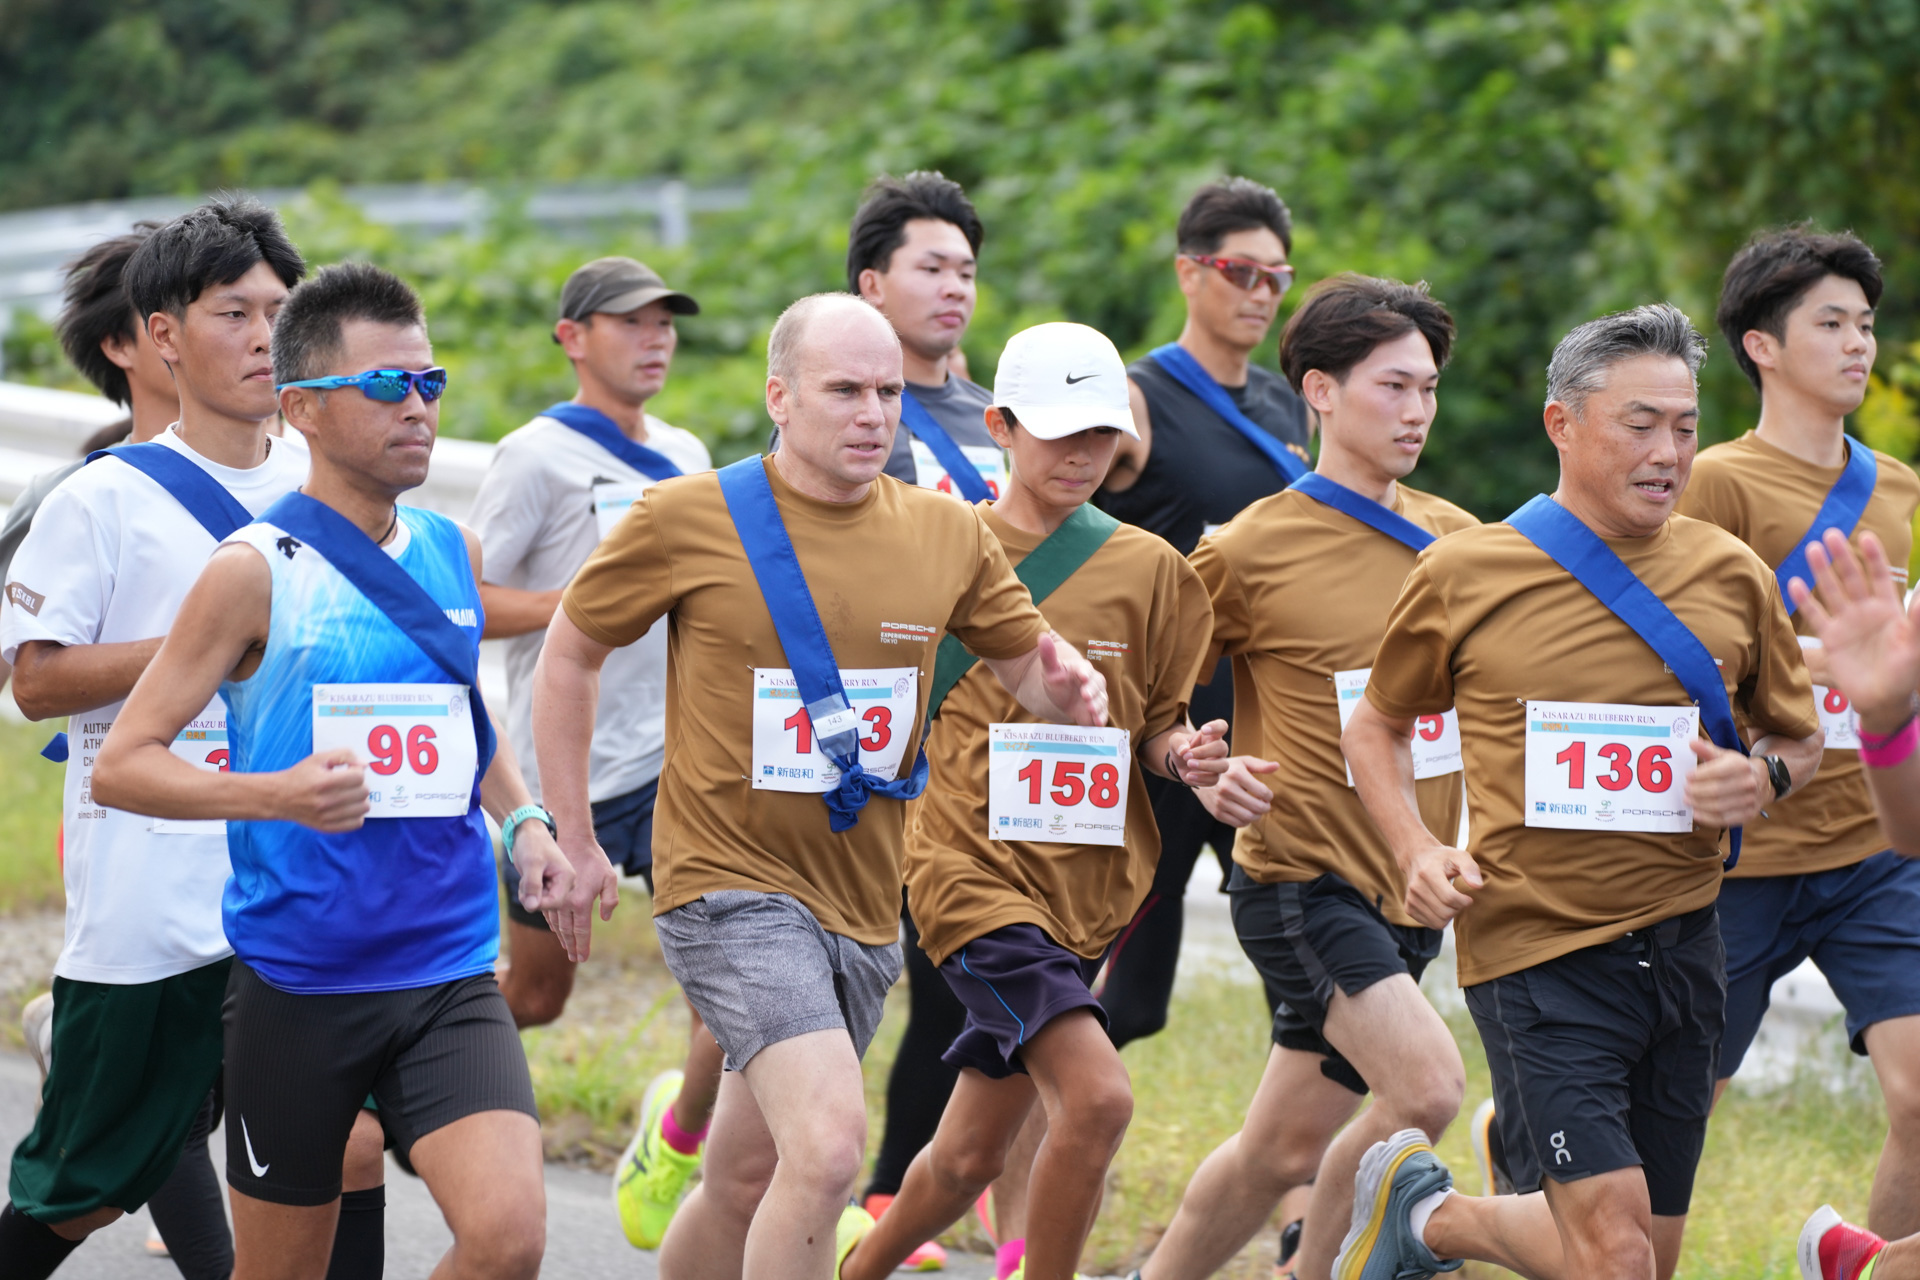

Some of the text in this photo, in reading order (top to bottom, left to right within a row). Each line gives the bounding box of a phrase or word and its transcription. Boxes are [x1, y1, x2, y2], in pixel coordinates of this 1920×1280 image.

[881, 622, 936, 633] PORSCHE
[880, 632, 911, 640] EXPERIENCE
[861, 679, 878, 687] RUN
[330, 694, 433, 703] KISARAZU BLUEBERRY RUN
[1542, 711, 1656, 724] KISARAZU BLUEBERRY RUN
[784, 706, 892, 754] 13
[1004, 732, 1043, 740] KISARAZU
[1045, 733, 1088, 742] BLUEBERRY
[367, 724, 439, 776] 96
[1556, 741, 1673, 793] 136
[776, 767, 814, 779] 新昭和
[1018, 759, 1120, 809] 158
[415, 792, 467, 800] PORSCHE
[1549, 803, 1587, 815] 新昭和
[1622, 808, 1687, 817] PORSCHE
[1012, 817, 1042, 828] 新昭和
